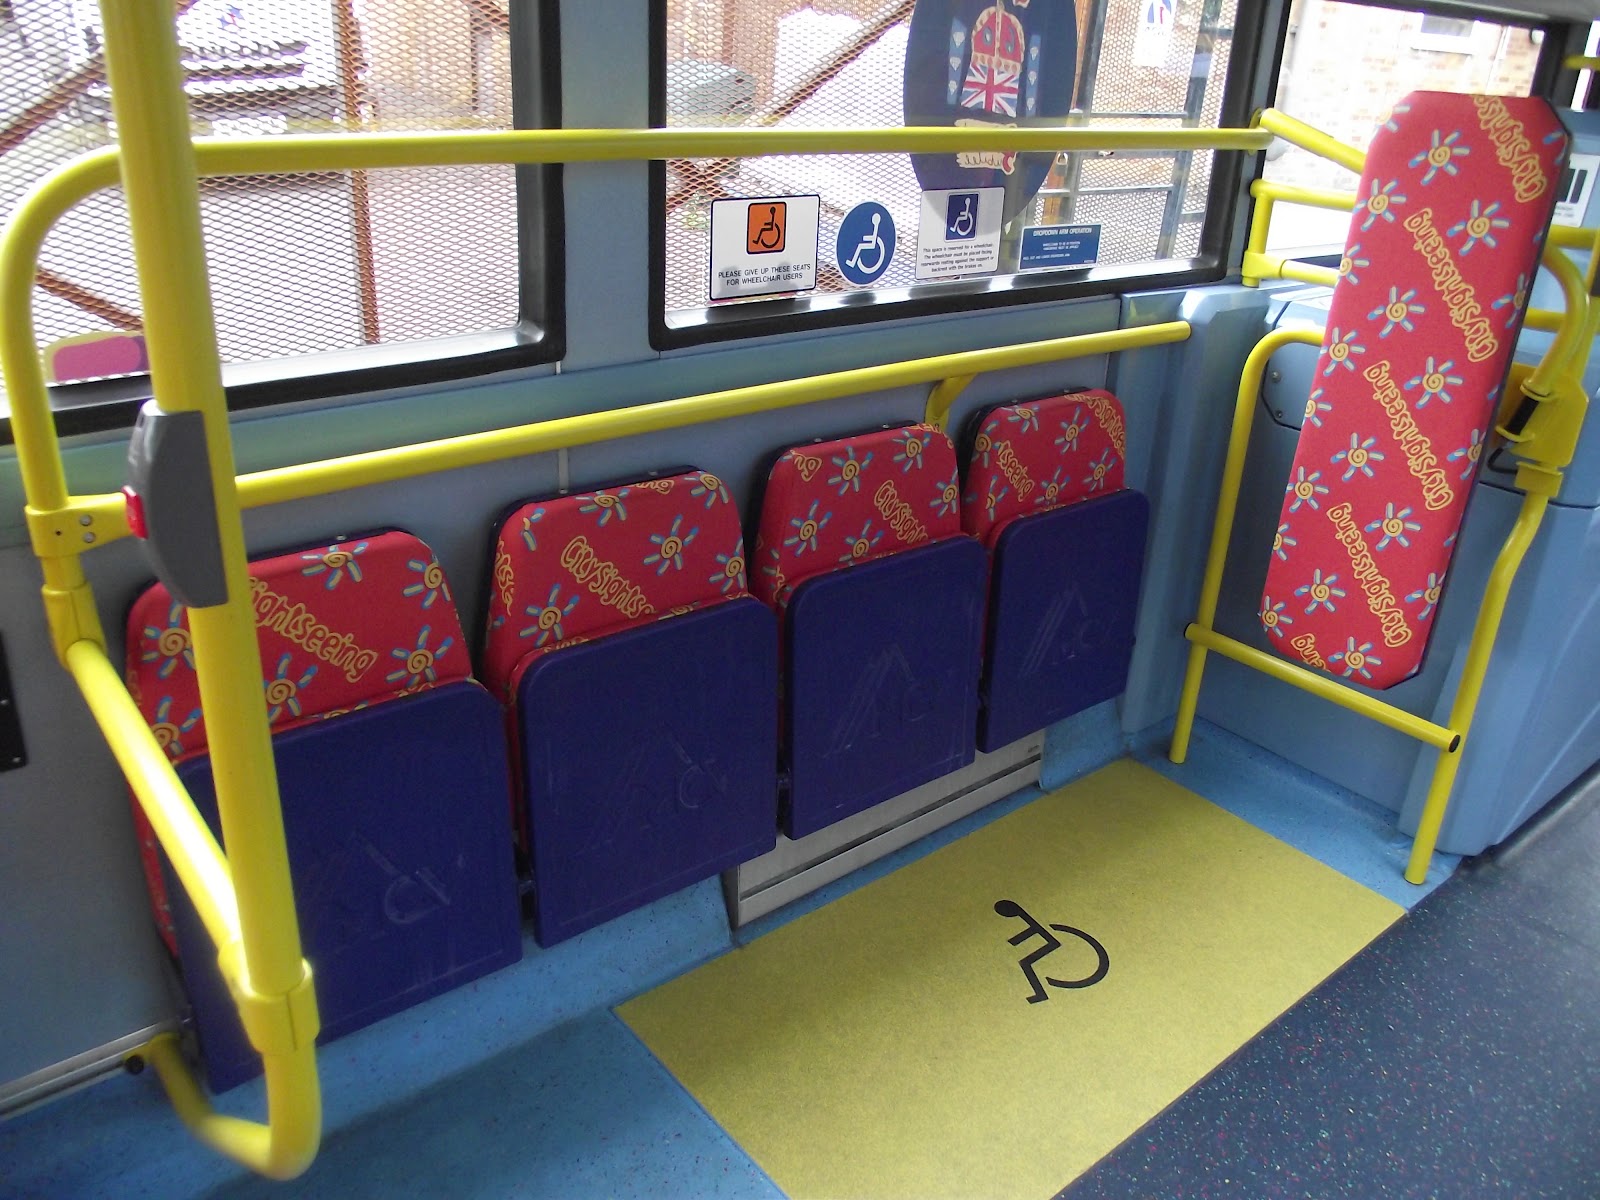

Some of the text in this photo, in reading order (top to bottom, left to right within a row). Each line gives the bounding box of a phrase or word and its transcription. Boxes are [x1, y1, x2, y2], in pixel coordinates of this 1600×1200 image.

[718, 270, 741, 278] PLEASE
[771, 265, 790, 274] THESE
[742, 275, 780, 284] WHEELCHAIR
